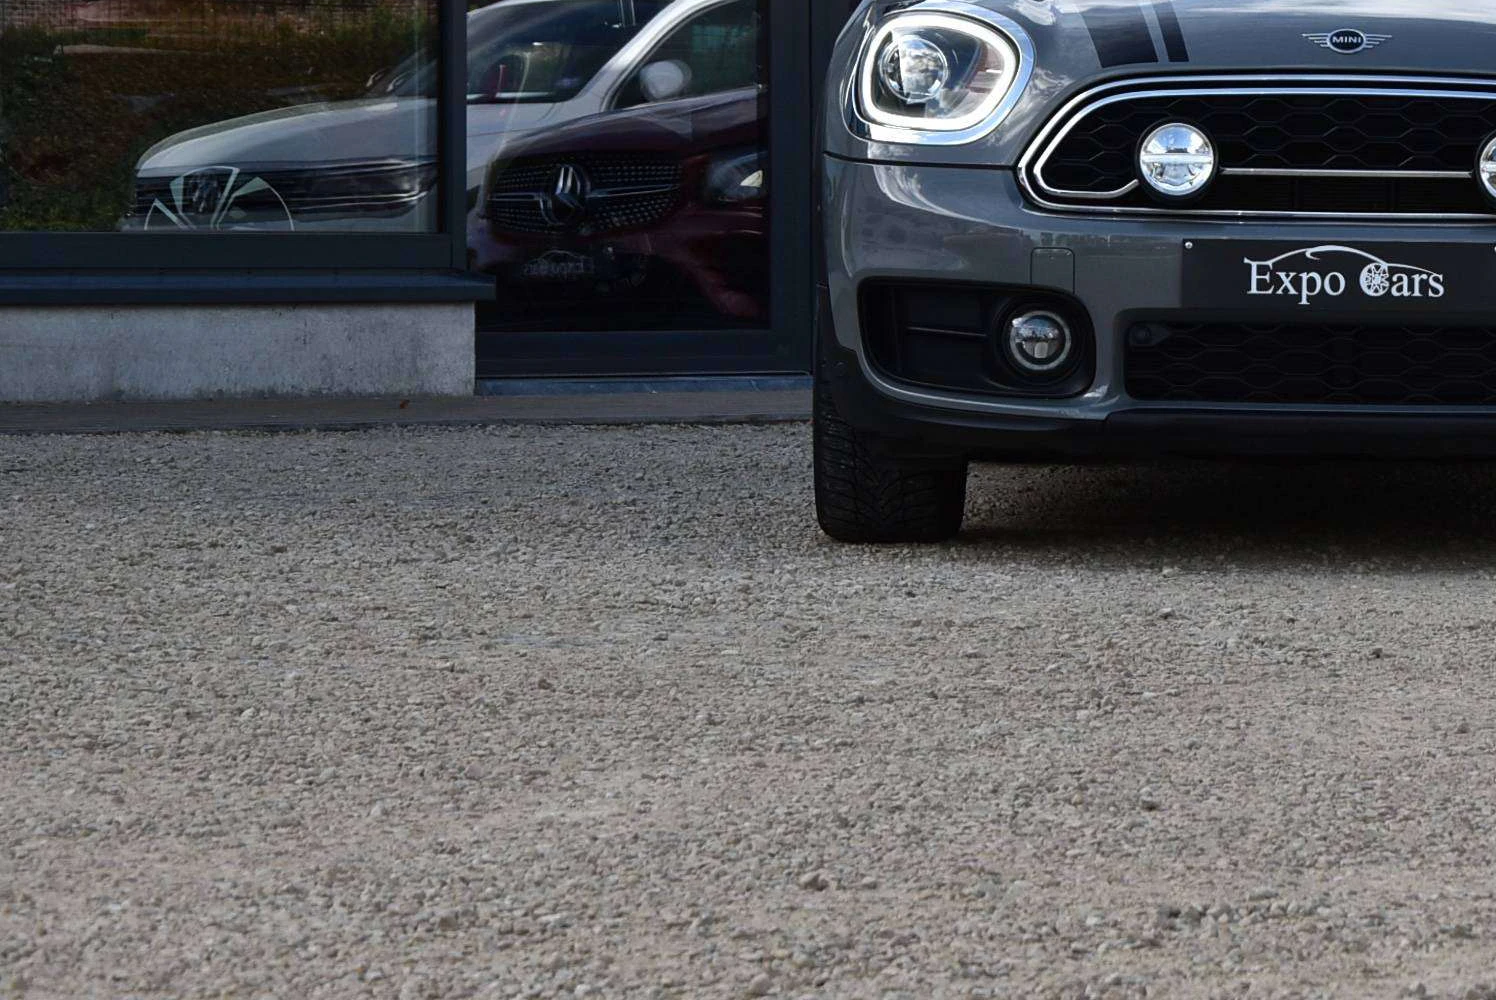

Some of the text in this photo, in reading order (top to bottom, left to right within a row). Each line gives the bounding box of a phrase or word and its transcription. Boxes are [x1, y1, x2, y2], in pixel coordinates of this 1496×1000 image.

[1332, 36, 1362, 44] MINI
[1246, 260, 1445, 305] Expo Cars
